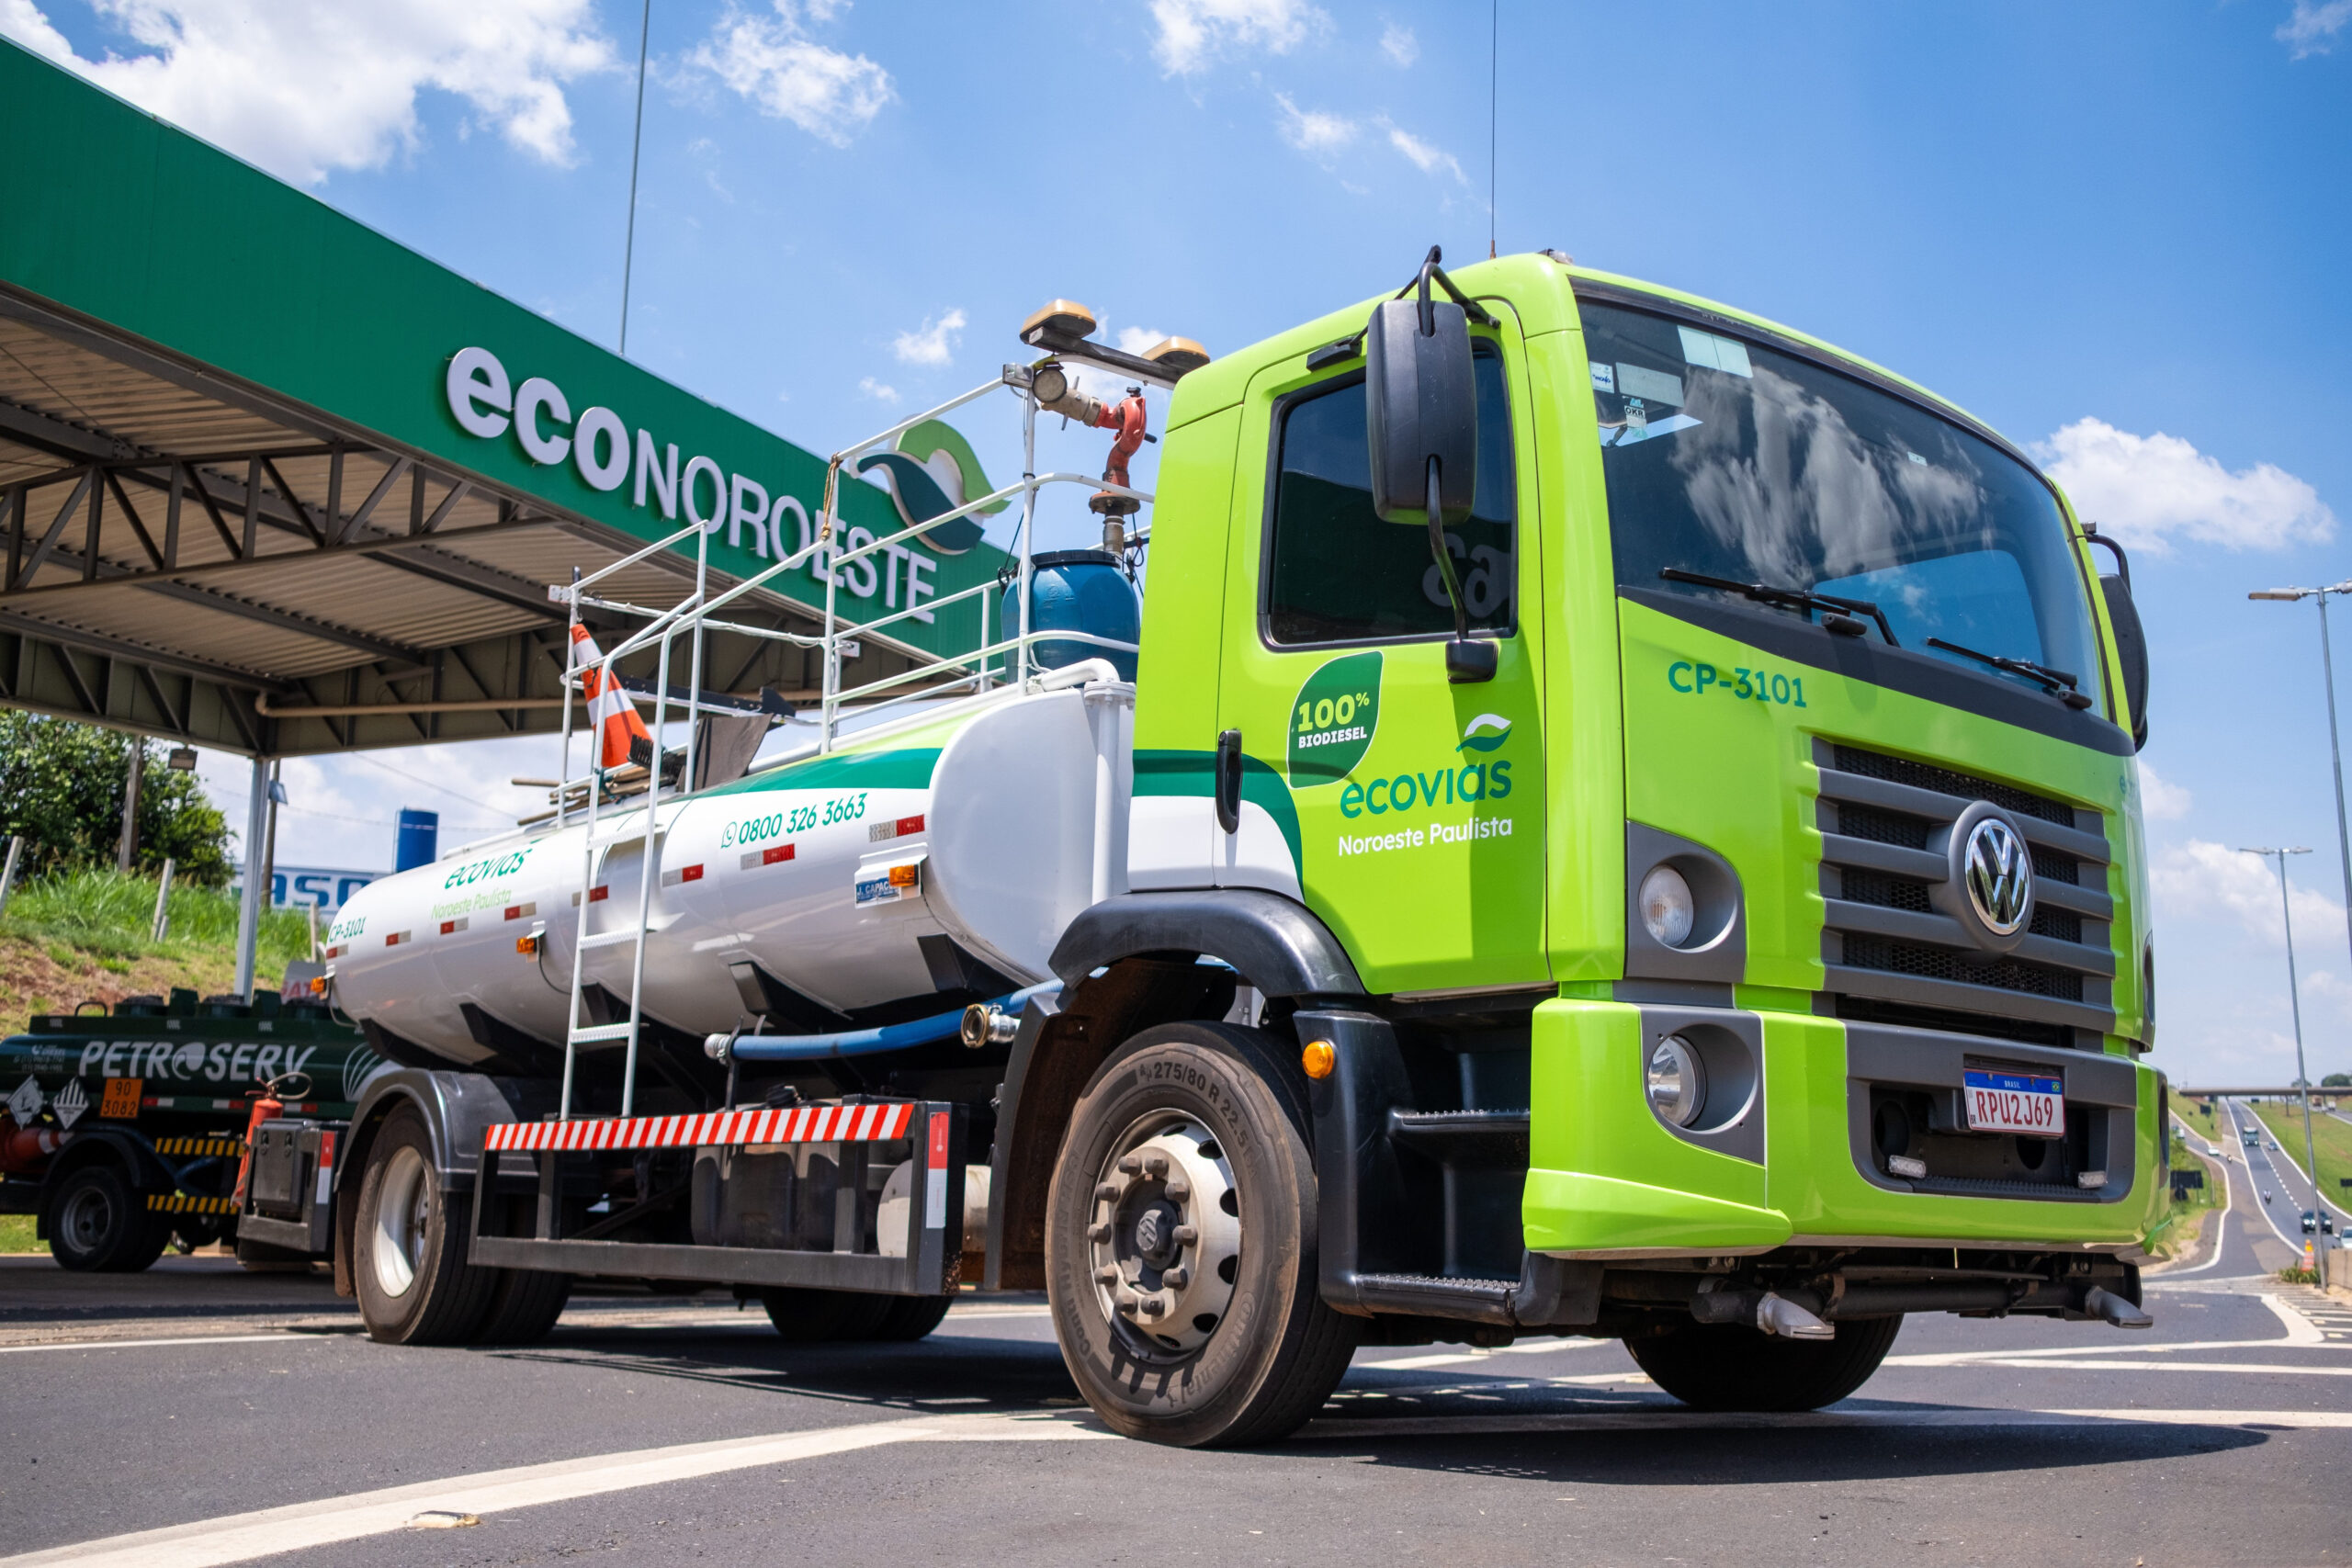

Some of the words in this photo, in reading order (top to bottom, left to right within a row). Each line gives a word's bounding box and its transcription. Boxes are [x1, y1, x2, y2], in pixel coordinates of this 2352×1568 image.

[1668, 661, 1807, 708] CP-3101
[1298, 692, 1370, 732] 100%
[1298, 727, 1367, 749] BIODIESEL
[1340, 761, 1512, 818] ecovias
[739, 814, 783, 844] 0800
[786, 805, 817, 834] 326
[822, 793, 868, 826] 3663
[1339, 829, 1424, 856] Noroeste
[1430, 817, 1512, 844] Paulista
[445, 848, 533, 889] ecovias
[431, 897, 472, 920] Noroeste
[472, 888, 512, 912] Paulista
[329, 917, 367, 942] CP-3101
[116, 1081, 130, 1096] 90
[2004, 1080, 2021, 1089] BRASIL
[104, 1100, 136, 1116] 3082
[1154, 1062, 1206, 1090] 275/80
[1208, 1081, 1220, 1103] R
[1220, 1099, 1250, 1146] 22.5
[1976, 1090, 2053, 1126] RPU2J69
